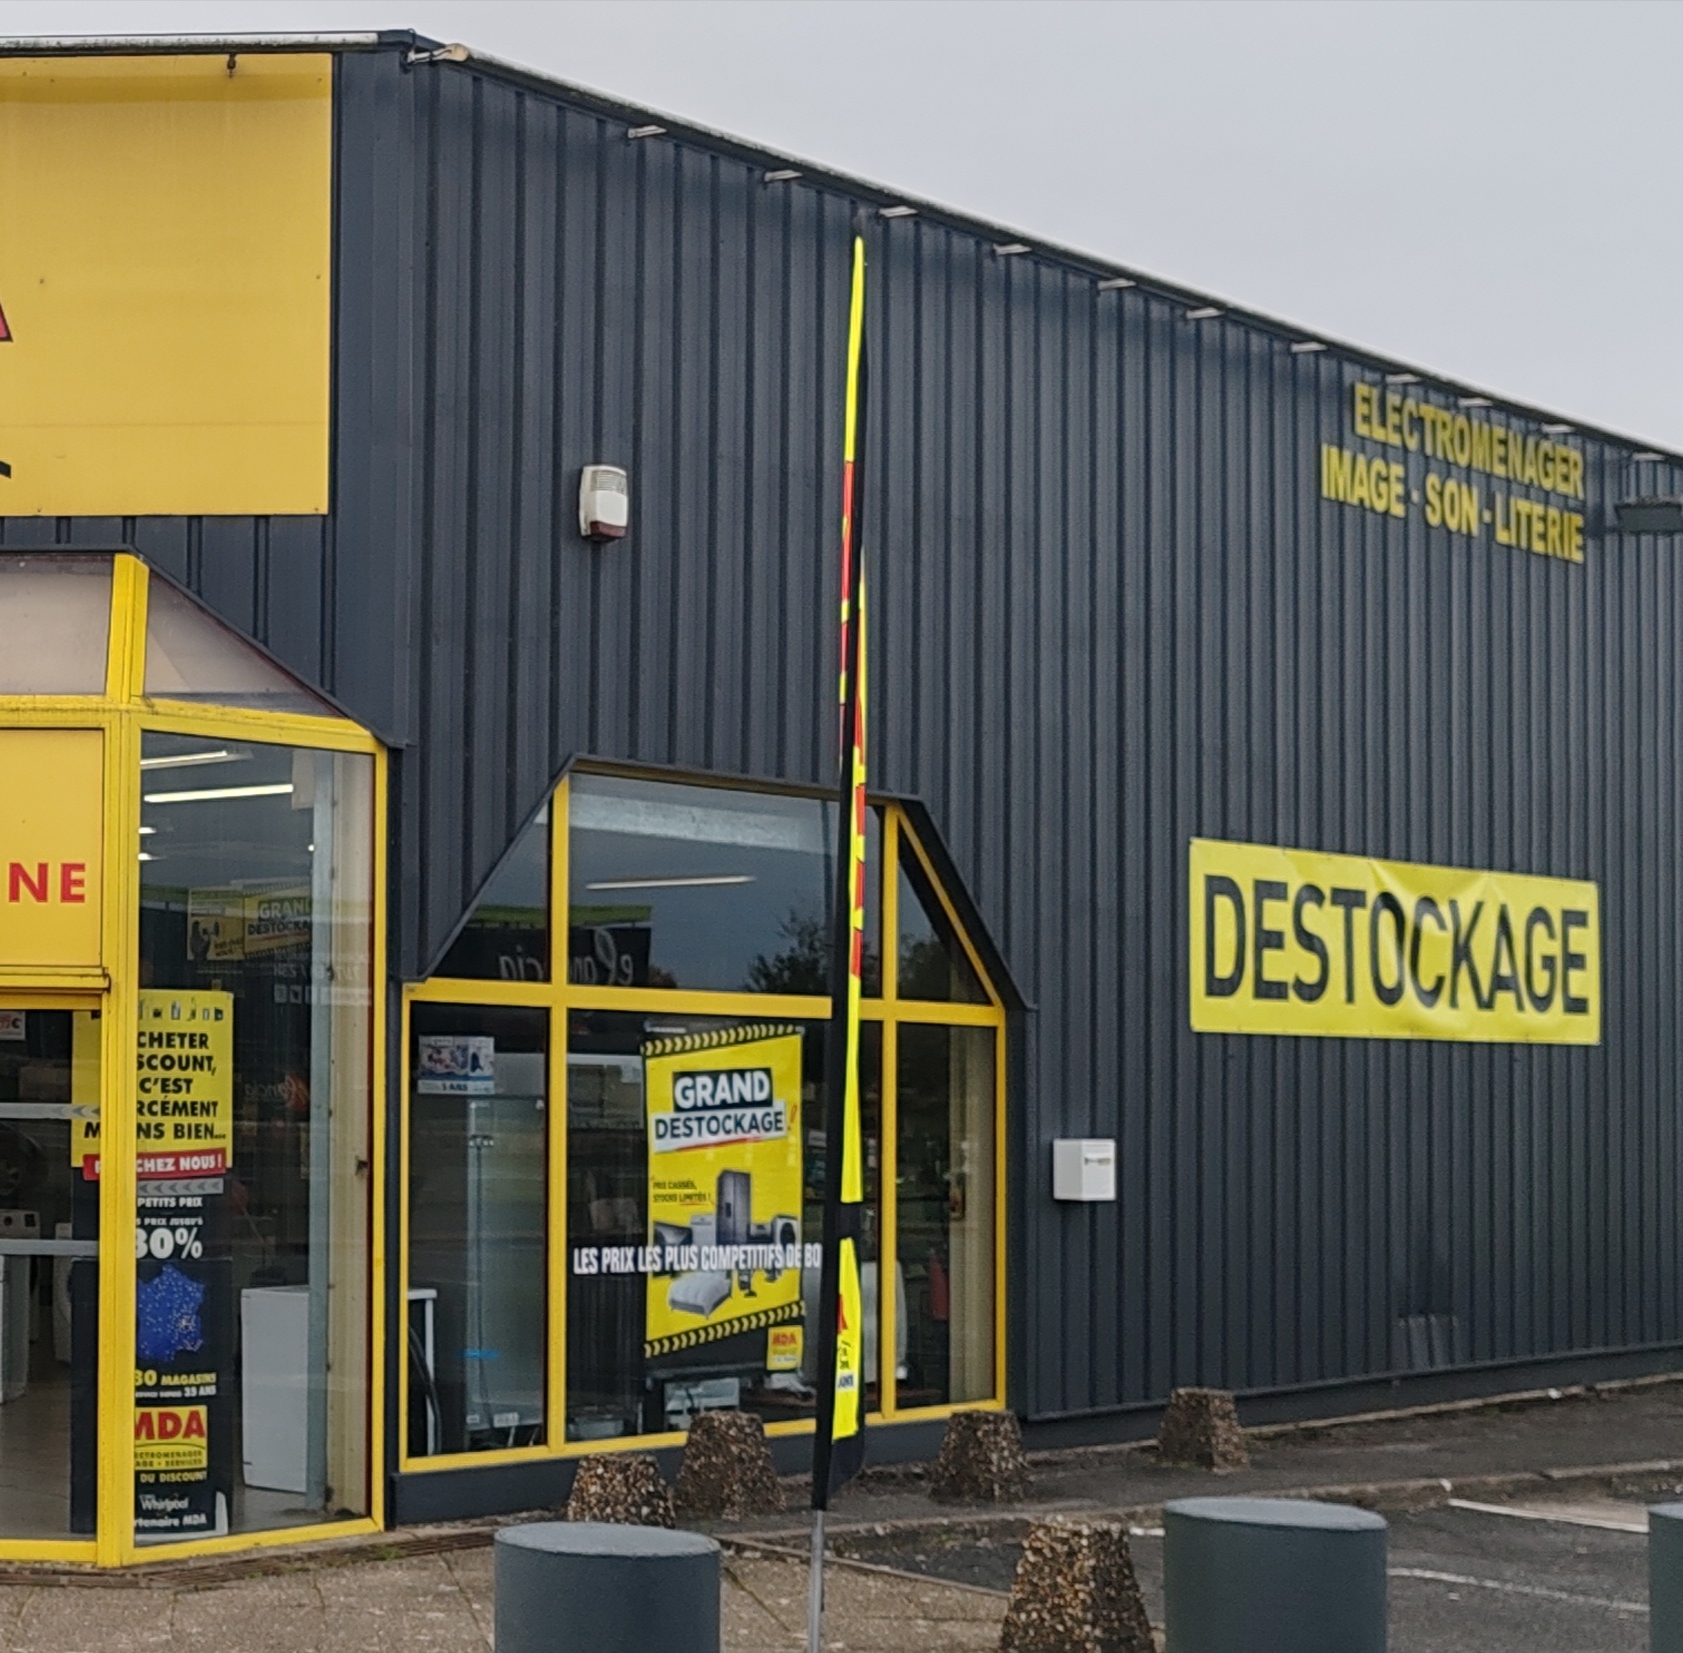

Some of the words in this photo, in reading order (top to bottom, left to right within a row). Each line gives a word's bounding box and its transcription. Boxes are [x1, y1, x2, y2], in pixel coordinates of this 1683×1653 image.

[1354, 381, 1584, 499] ELECTROMENAGER
[1321, 444, 1405, 518] IMAGE
[1426, 473, 1479, 537] SON
[1495, 491, 1584, 563] LITERIE
[1204, 874, 1590, 1015] DESTOCKAGE
[137, 1031, 209, 1049] CHETER
[137, 1054, 216, 1076] SCOUNT,
[139, 1077, 193, 1094] C'EST
[674, 1071, 770, 1109] GRAND
[137, 1095, 218, 1117] RCÉMENT
[84, 1121, 165, 1139] MNS
[655, 1111, 783, 1139] DESTOCKAGE
[179, 1155, 216, 1171] NOUS
[137, 1197, 176, 1207] PETITS
[179, 1197, 203, 1207] PRIX
[574, 1247, 598, 1274] LES
[602, 1246, 635, 1273] PRIX
[638, 1246, 662, 1271] LES
[667, 1245, 698, 1271] PLUS
[701, 1243, 783, 1270] COMPETITIFS
[786, 1243, 801, 1268] DE
[805, 1243, 822, 1268] BO
[160, 1372, 217, 1385] MAGASINS
[199, 1385, 217, 1396] ANS
[135, 1410, 205, 1440] MDA
[140, 1473, 155, 1483] DU
[159, 1471, 207, 1483] DISCOUNT
